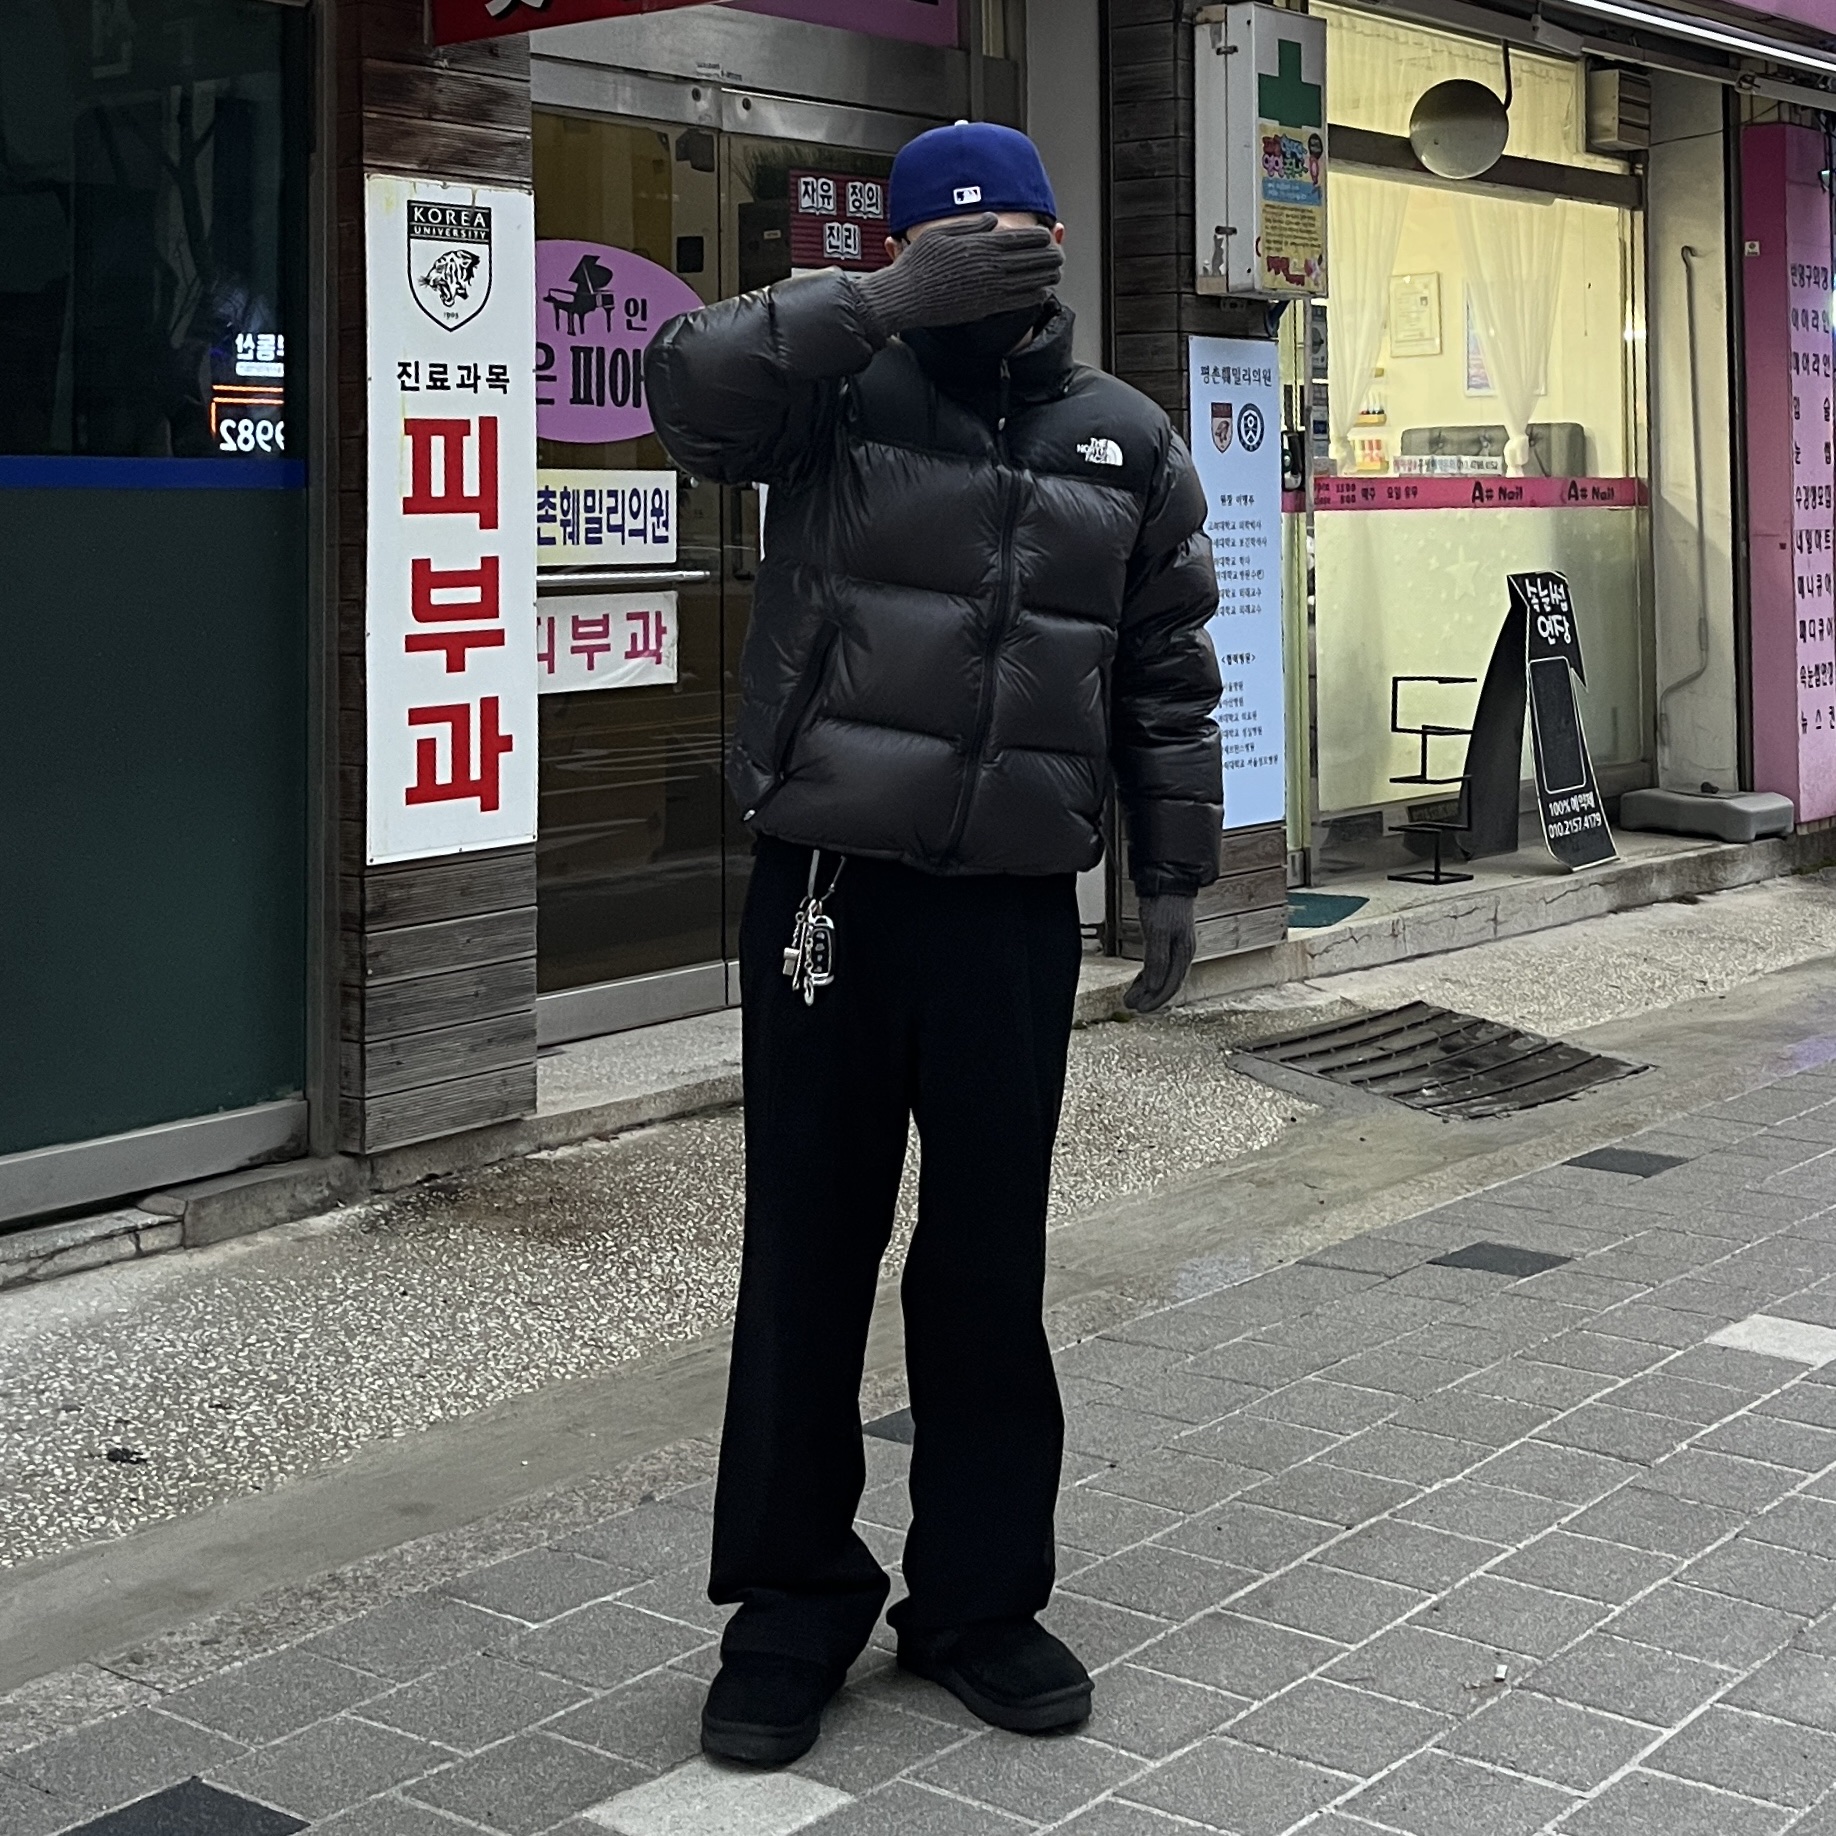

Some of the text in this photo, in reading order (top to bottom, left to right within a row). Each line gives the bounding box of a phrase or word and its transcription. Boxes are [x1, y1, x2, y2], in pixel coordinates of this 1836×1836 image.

[801, 181, 879, 212] 자유 정의
[413, 206, 486, 228] KOREA
[413, 226, 486, 240] UNIVERSITY
[827, 225, 857, 250] 진리
[624, 298, 648, 332] 인
[396, 360, 510, 394] 진료과목
[1498, 486, 1523, 501] Nail
[1591, 486, 1615, 501] Nail
[1795, 529, 1832, 554] 네일아트
[1525, 577, 1568, 612] 속눈썹
[402, 415, 514, 812] 피부과
[1537, 614, 1572, 646] 연장
[1549, 799, 1571, 817] 100%
